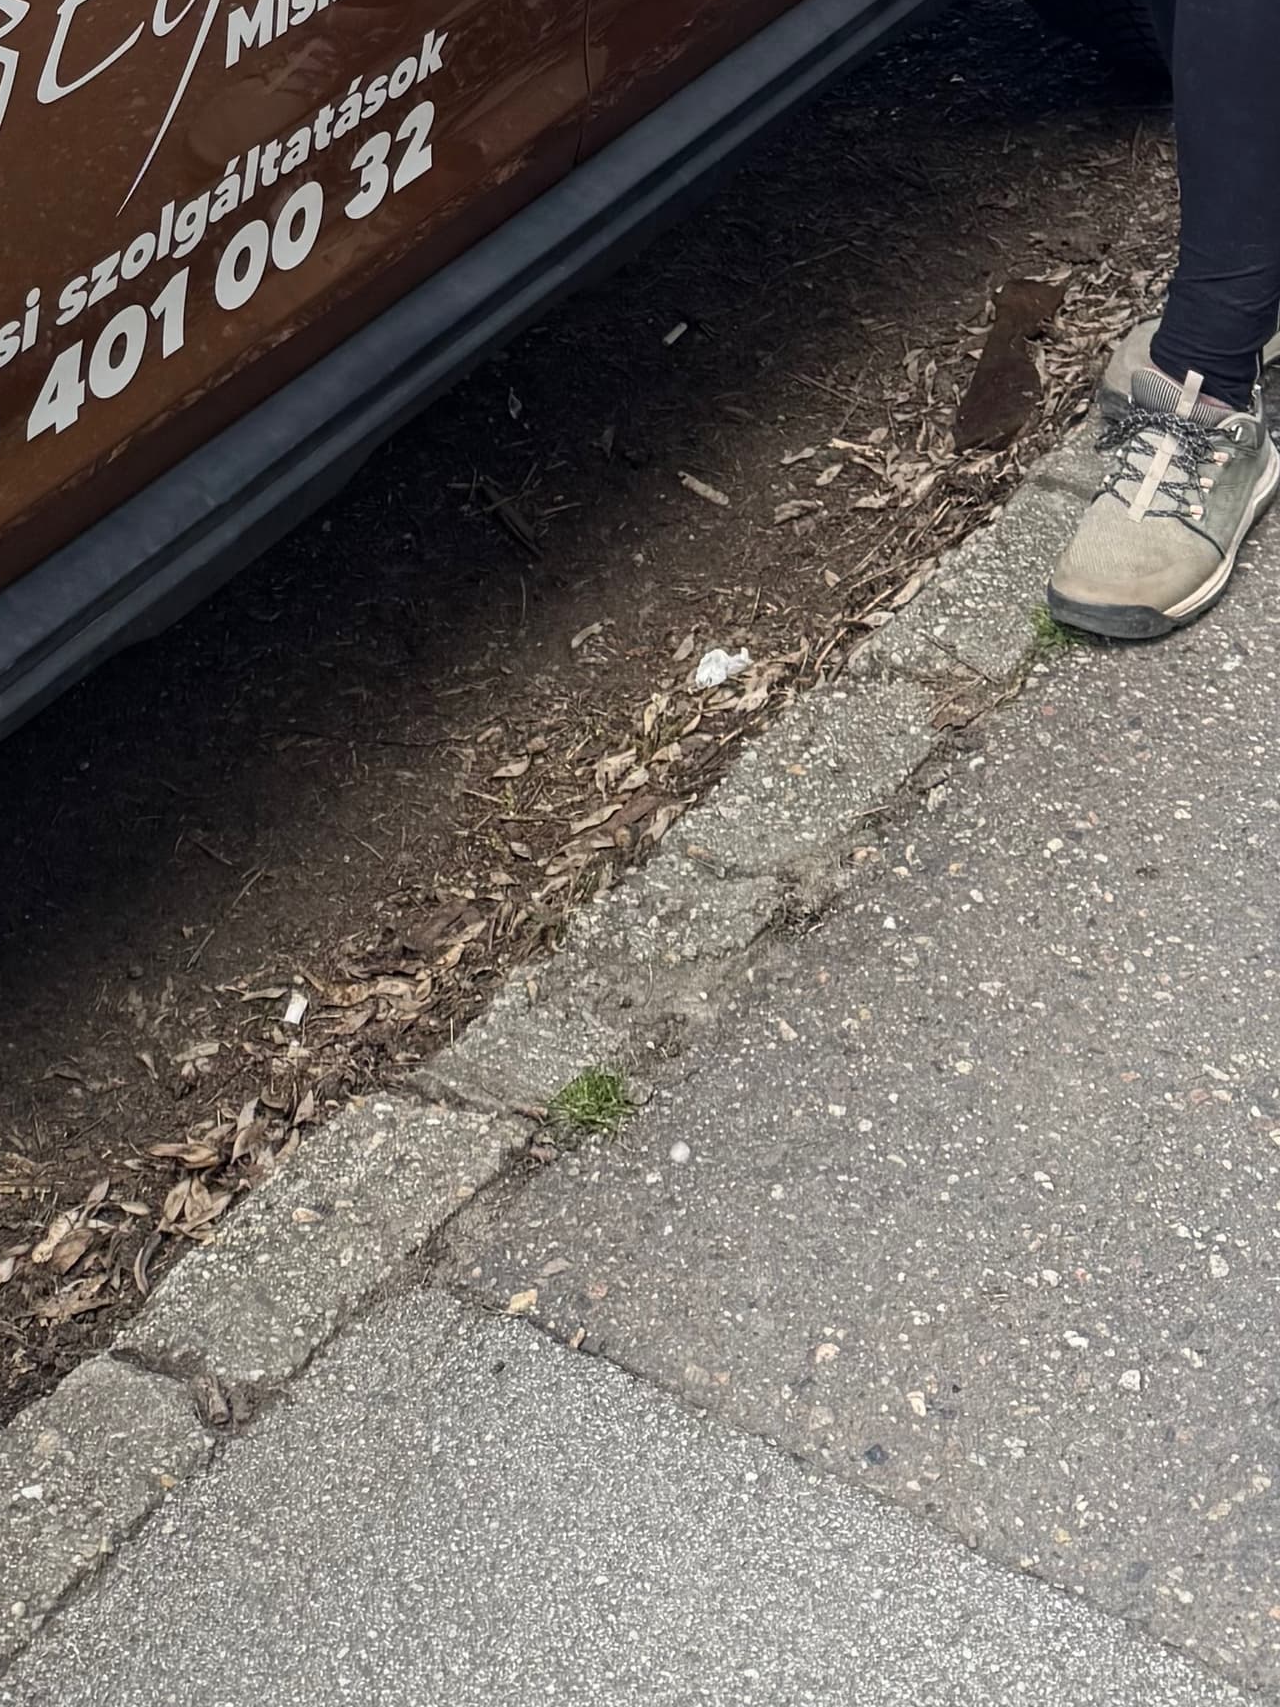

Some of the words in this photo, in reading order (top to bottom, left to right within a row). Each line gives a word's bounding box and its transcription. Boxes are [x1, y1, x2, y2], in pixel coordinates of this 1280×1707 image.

[26, 266, 190, 442] 401
[214, 181, 324, 311] 00
[344, 100, 435, 220] 32
[55, 29, 449, 326] szolgáltatások
